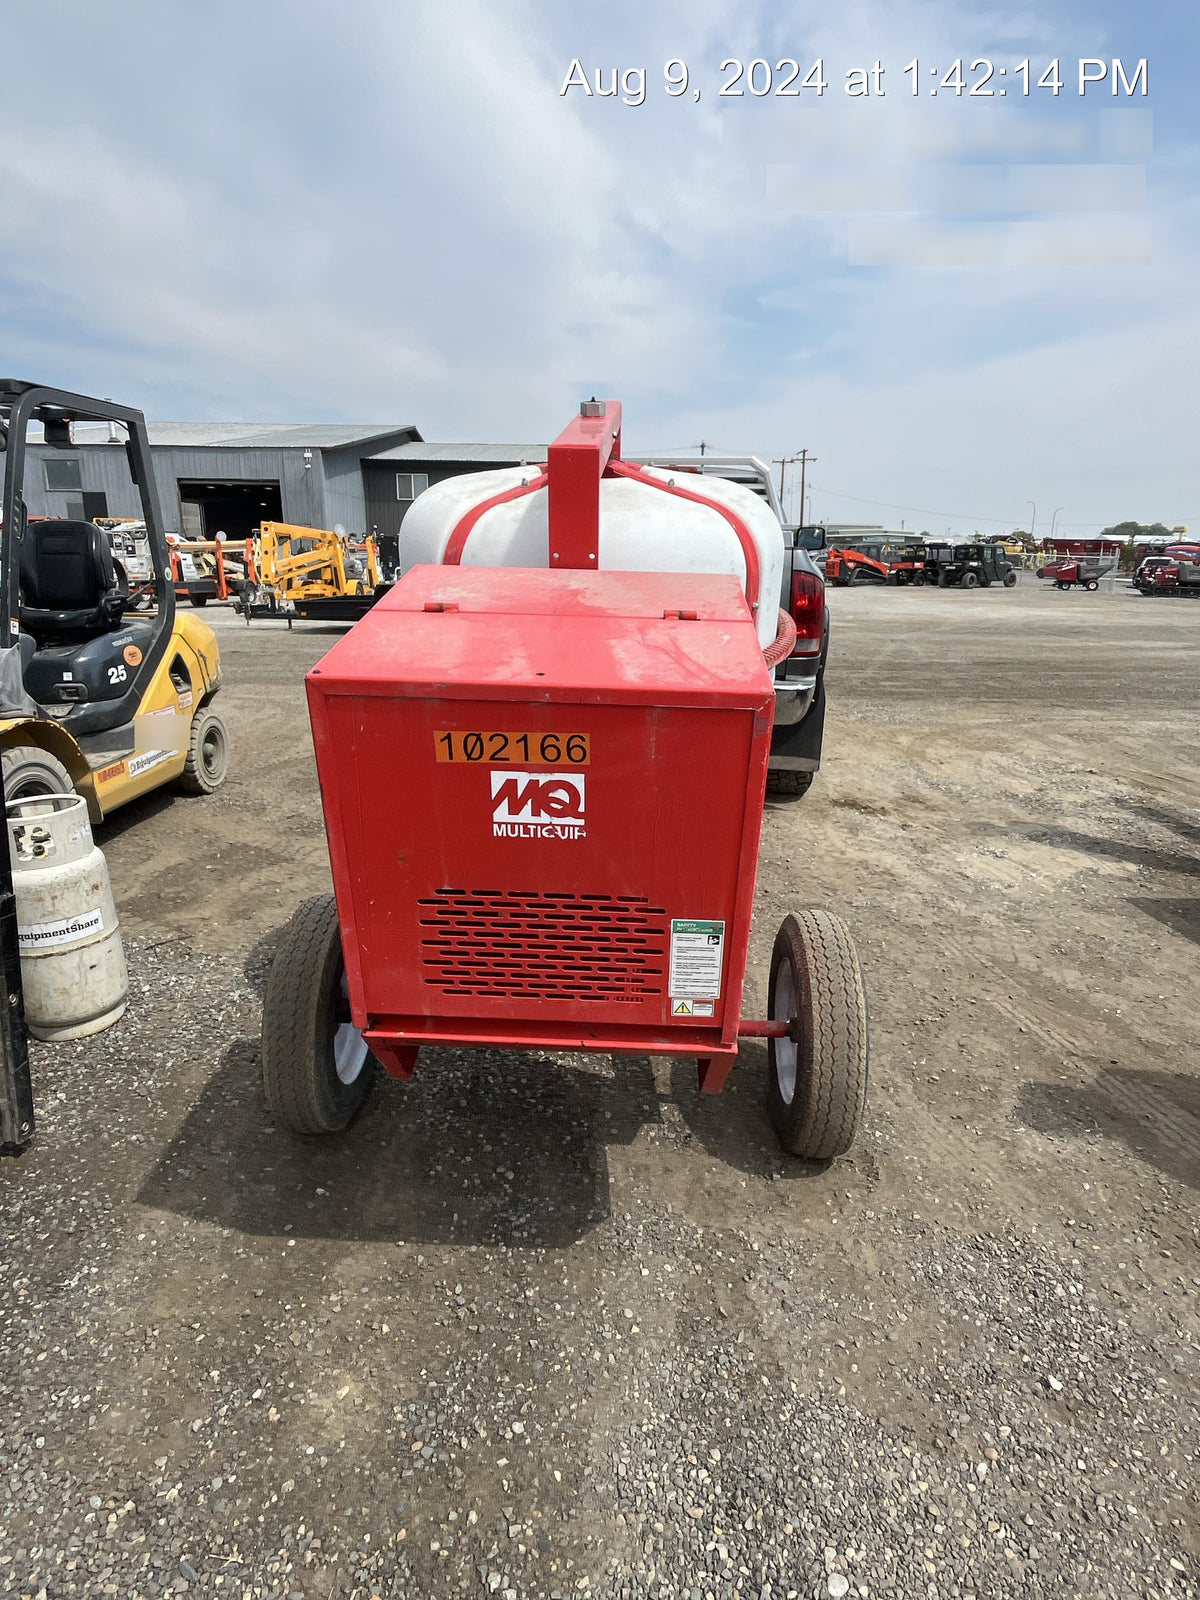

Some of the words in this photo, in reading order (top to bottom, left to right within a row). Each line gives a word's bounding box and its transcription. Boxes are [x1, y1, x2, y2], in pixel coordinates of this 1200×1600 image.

[108, 665, 127, 684] 25
[440, 732, 588, 764] 102166
[492, 778, 585, 819] MQ
[17, 917, 99, 942] quipmentShare
